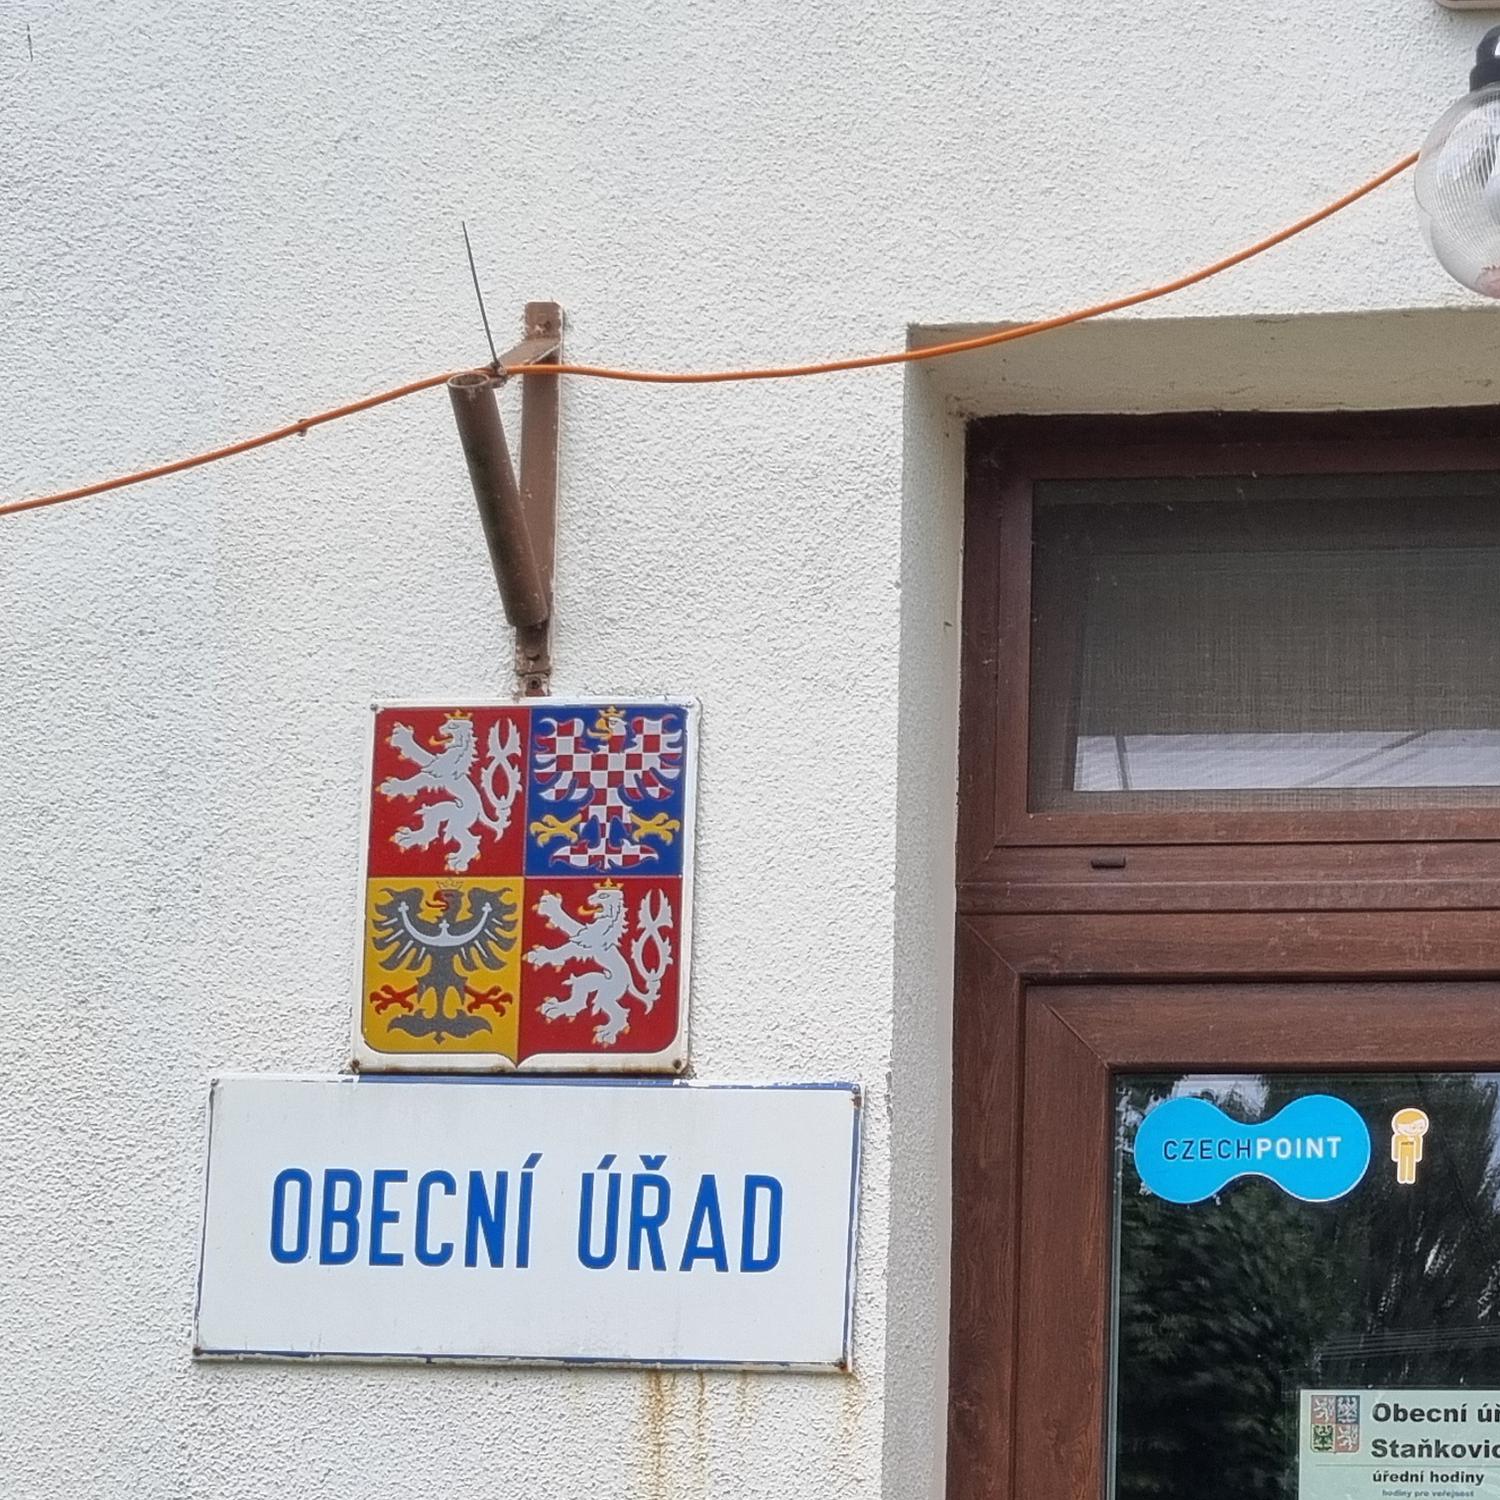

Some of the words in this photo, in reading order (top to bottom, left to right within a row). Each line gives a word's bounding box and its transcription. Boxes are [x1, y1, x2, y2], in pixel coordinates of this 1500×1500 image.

[269, 1152, 544, 1269] OBECNÍ
[576, 1154, 784, 1273] ÚŘAD
[1372, 1403, 1467, 1423] Obecní
[1372, 1470, 1424, 1483] úřední
[1430, 1471, 1485, 1486] hodiny
